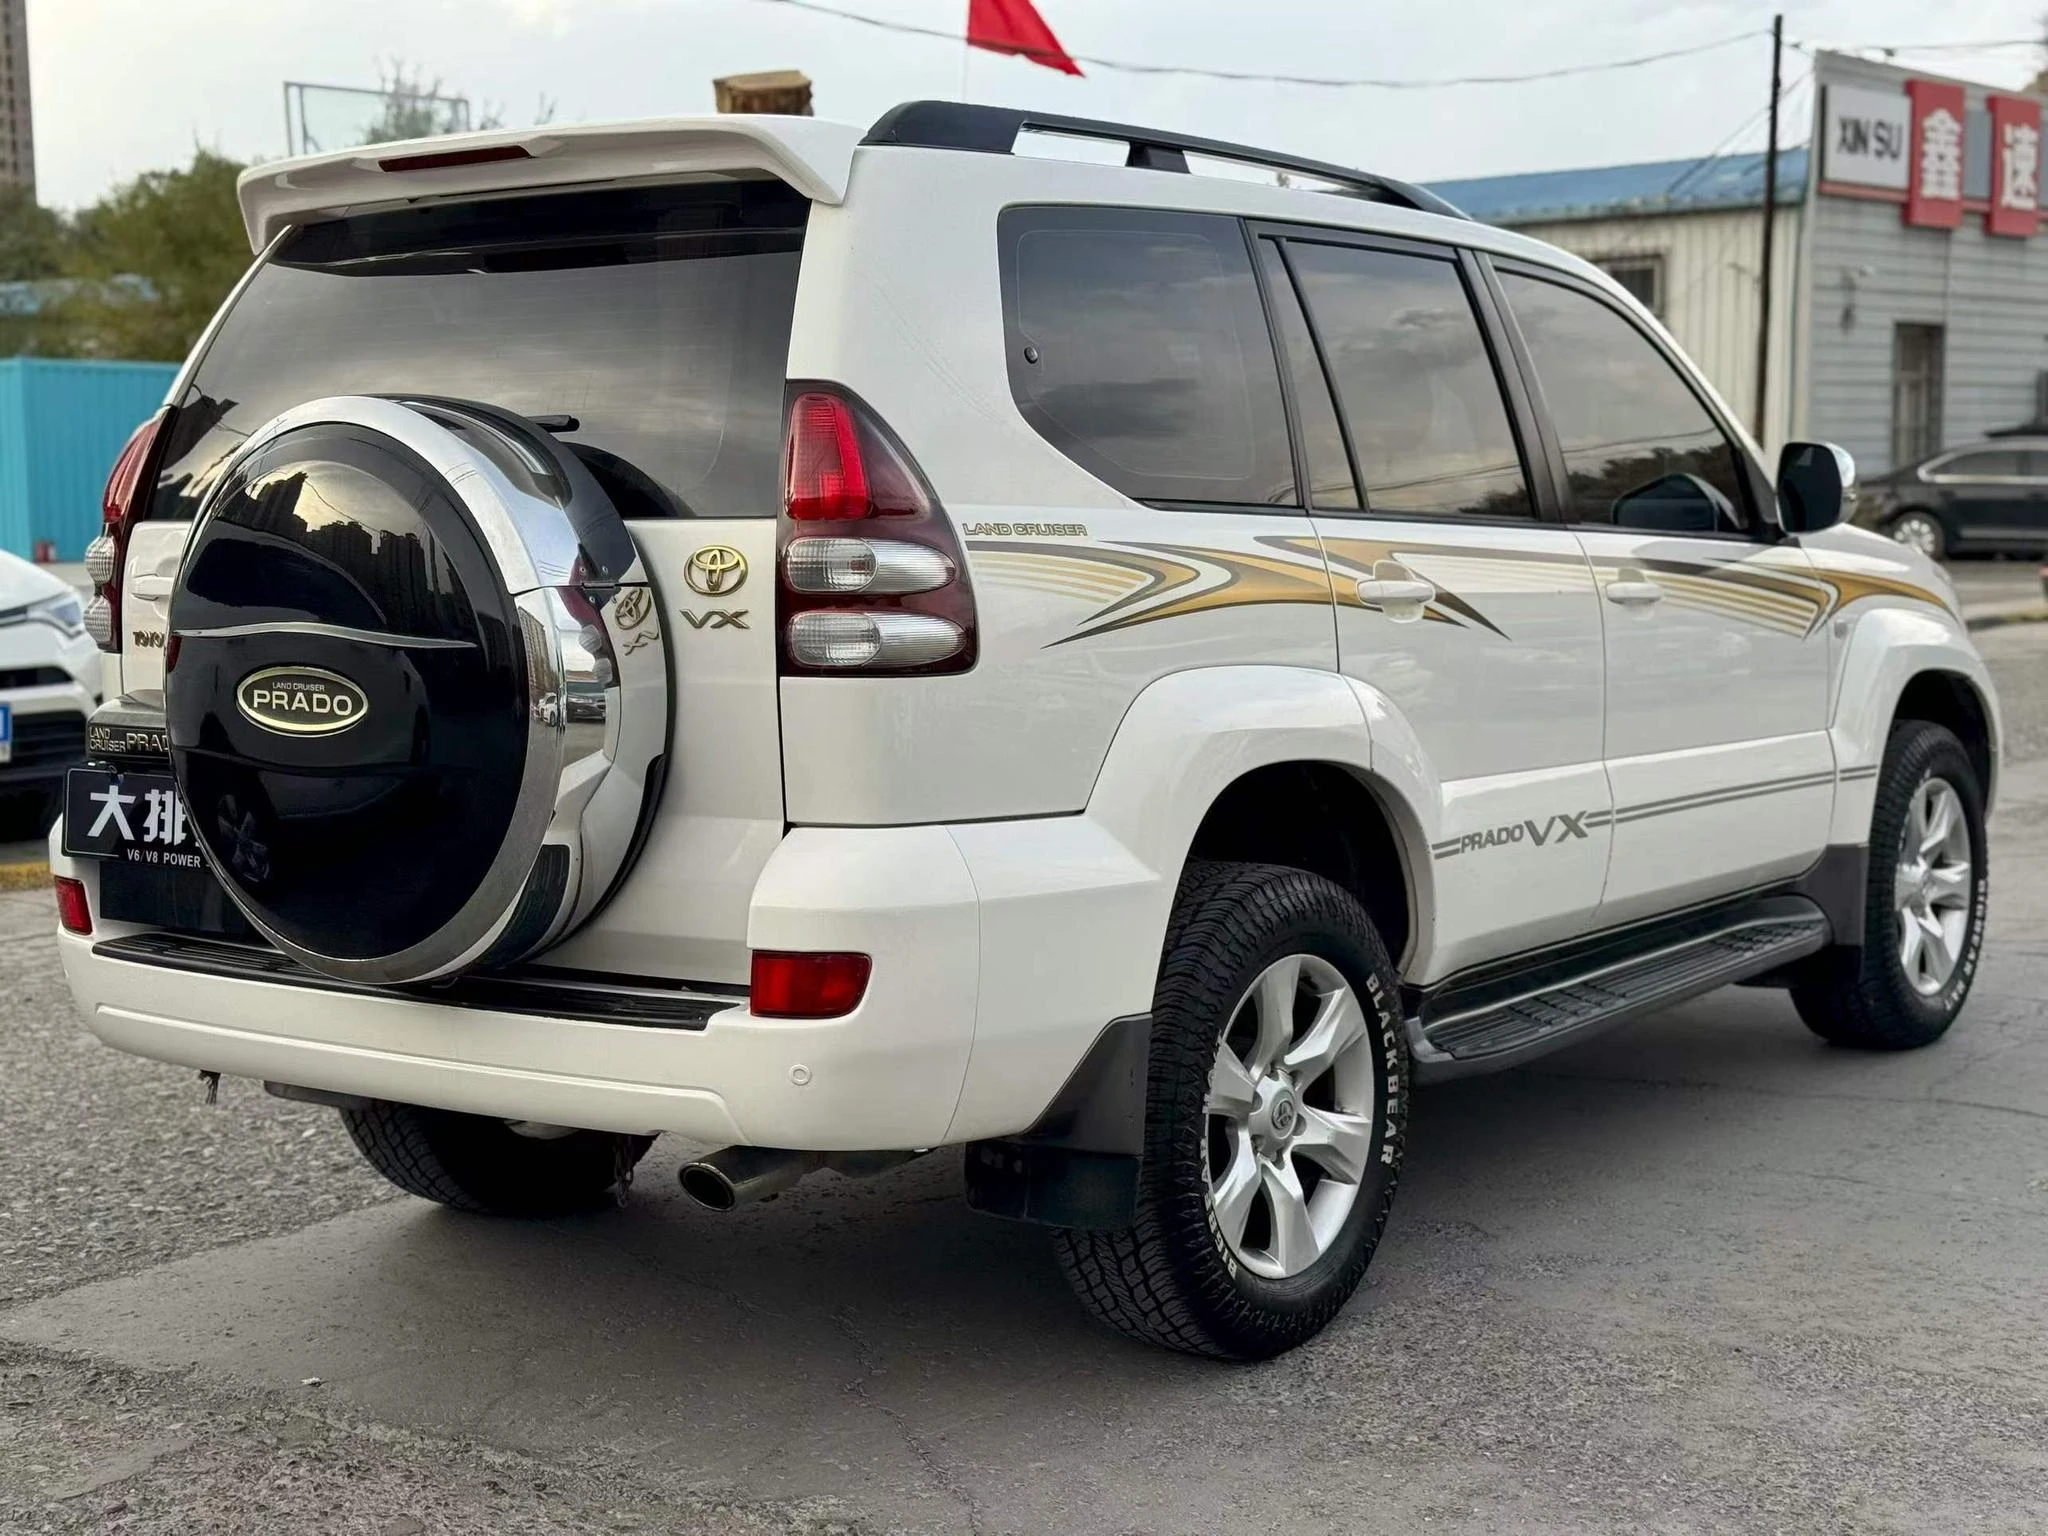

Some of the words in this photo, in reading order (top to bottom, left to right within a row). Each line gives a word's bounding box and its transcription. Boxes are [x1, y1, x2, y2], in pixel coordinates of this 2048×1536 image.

[1837, 116, 1871, 155] XIN
[1873, 119, 1902, 160] SU
[962, 523, 1012, 536] LAND
[1013, 523, 1088, 536] CRUISER
[680, 608, 752, 631] VX
[273, 681, 292, 690] LAND
[293, 682, 326, 692] CRUISER
[253, 689, 353, 716] PRADO
[89, 726, 111, 740] LAND
[89, 738, 126, 752] CRUISER
[87, 785, 200, 847] 大排
[1461, 824, 1525, 853] PRADO
[1524, 810, 1588, 847] VX
[163, 852, 201, 868] POWER
[1366, 972, 1399, 1165] BLACKBEAR
